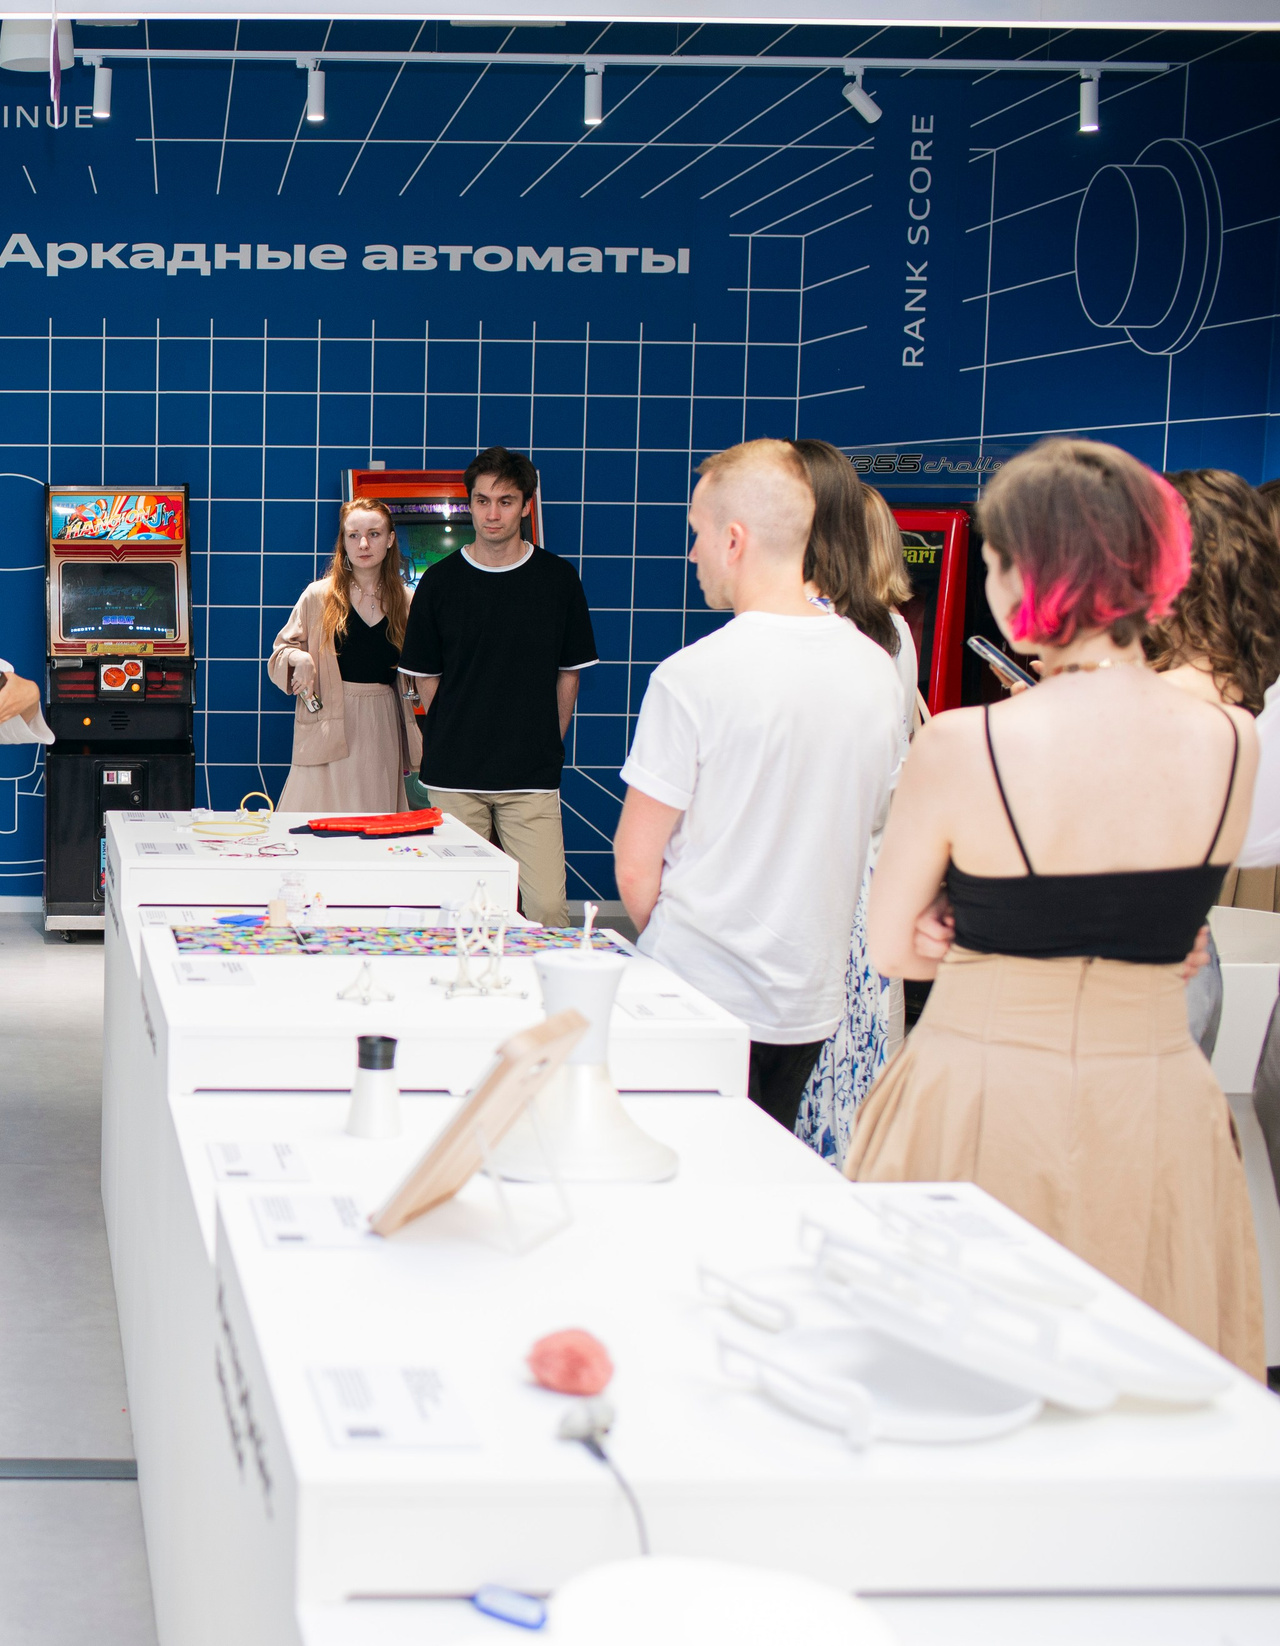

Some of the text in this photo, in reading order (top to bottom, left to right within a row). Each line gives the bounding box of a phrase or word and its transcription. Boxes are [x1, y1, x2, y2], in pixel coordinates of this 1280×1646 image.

[901, 113, 934, 367] RANK SCORE
[362, 244, 690, 274] автоматы
[923, 456, 1005, 474] challe
